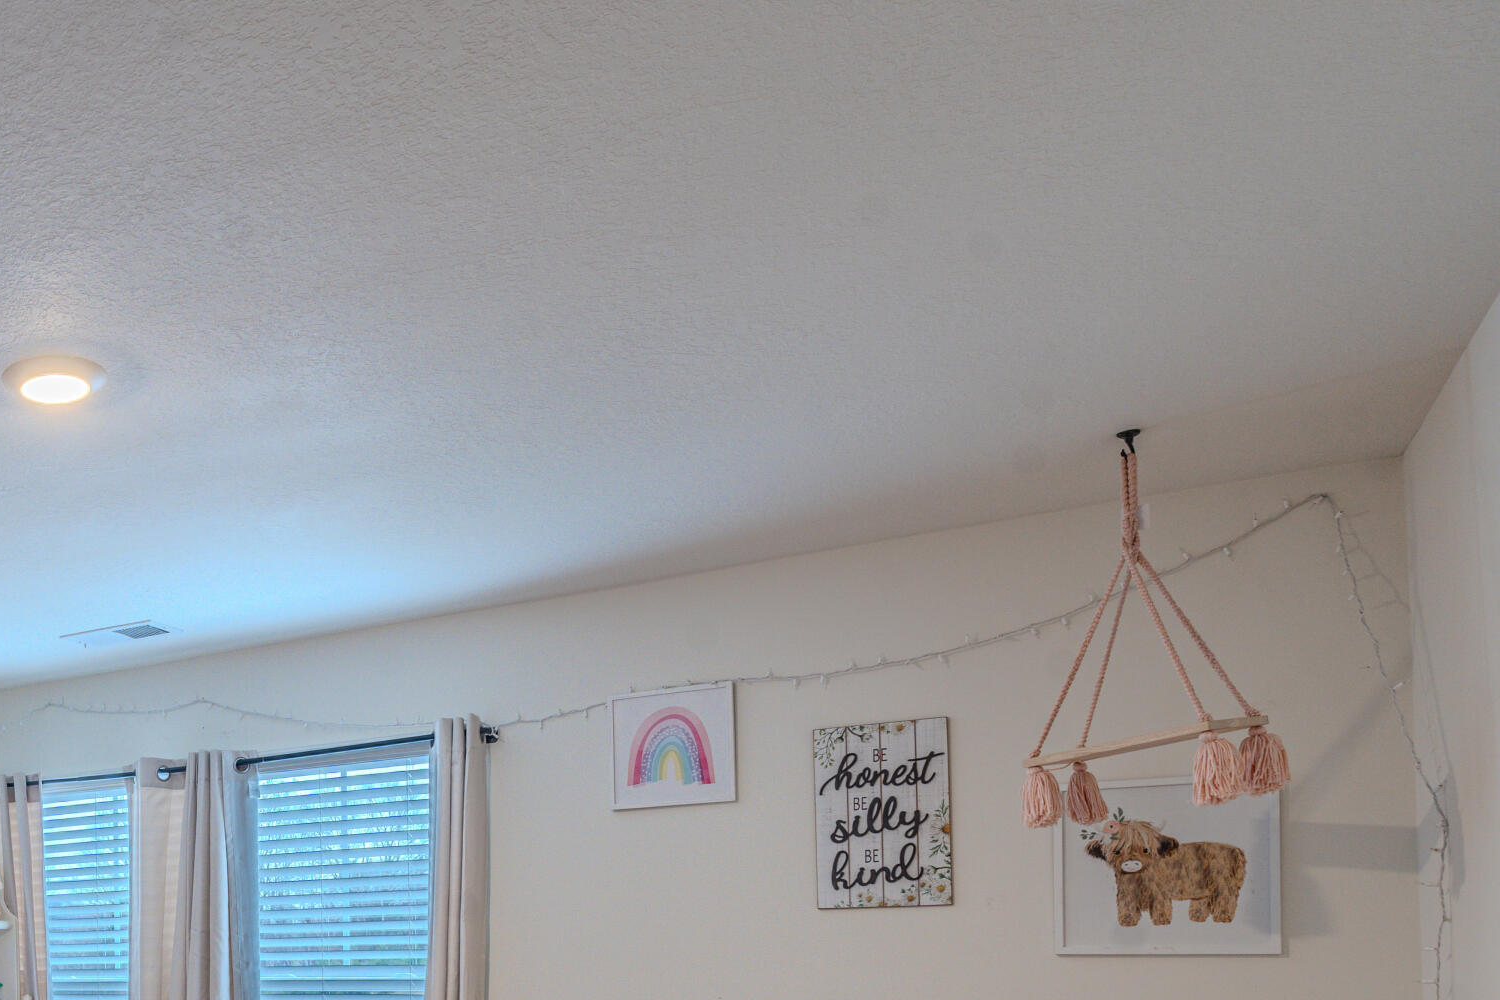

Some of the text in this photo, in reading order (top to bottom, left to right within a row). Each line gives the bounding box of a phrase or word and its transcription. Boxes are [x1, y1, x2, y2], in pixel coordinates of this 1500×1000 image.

[873, 748, 887, 763] BE
[819, 751, 945, 795] honest
[853, 797, 868, 811] BE
[830, 796, 929, 843] silly
[831, 843, 924, 891] kind
[865, 849, 880, 863] BE
